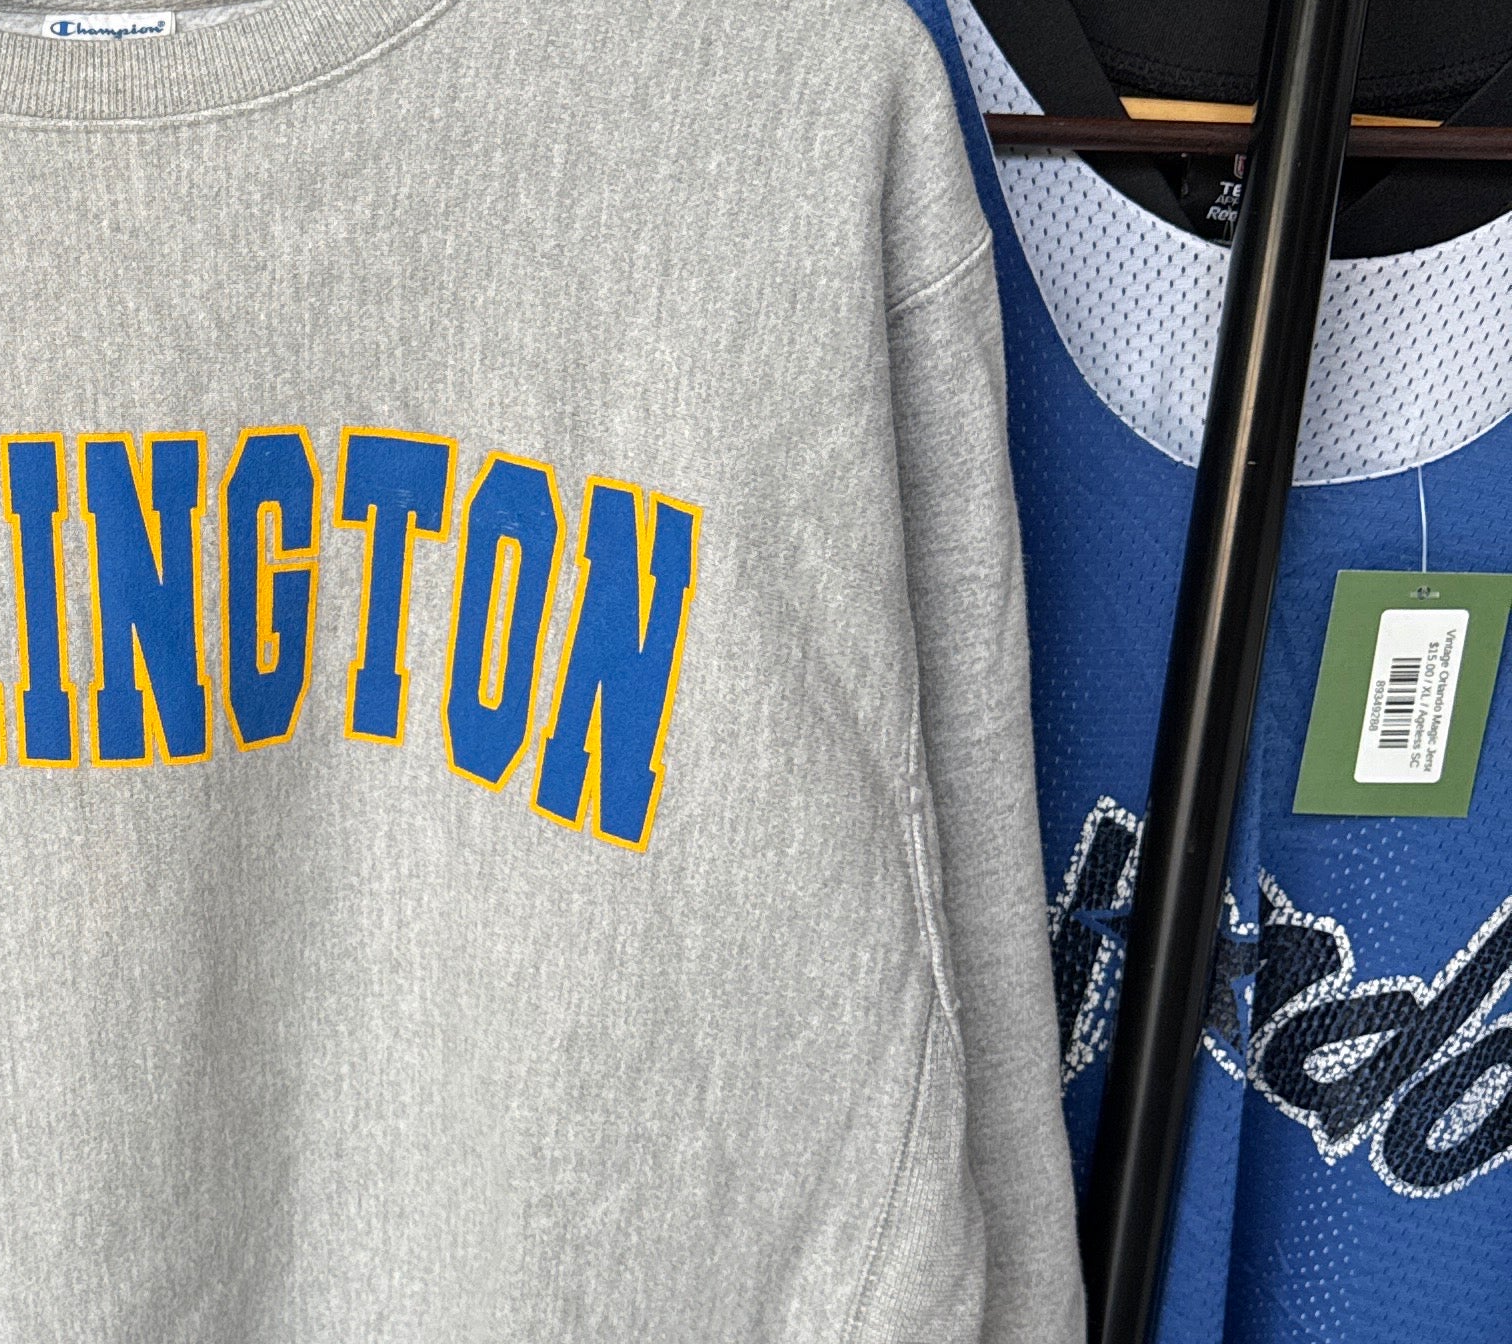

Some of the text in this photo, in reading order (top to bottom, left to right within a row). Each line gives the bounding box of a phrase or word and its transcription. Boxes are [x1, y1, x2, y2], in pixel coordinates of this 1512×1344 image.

[1425, 641, 1440, 677] $15.00
[1439, 629, 1457, 668] Vintage
[1419, 685, 1432, 700] XL
[1433, 671, 1450, 712] Orlando
[1412, 709, 1429, 750] Ageless
[1426, 715, 1443, 745] Magic
[1409, 752, 1421, 769] SC
